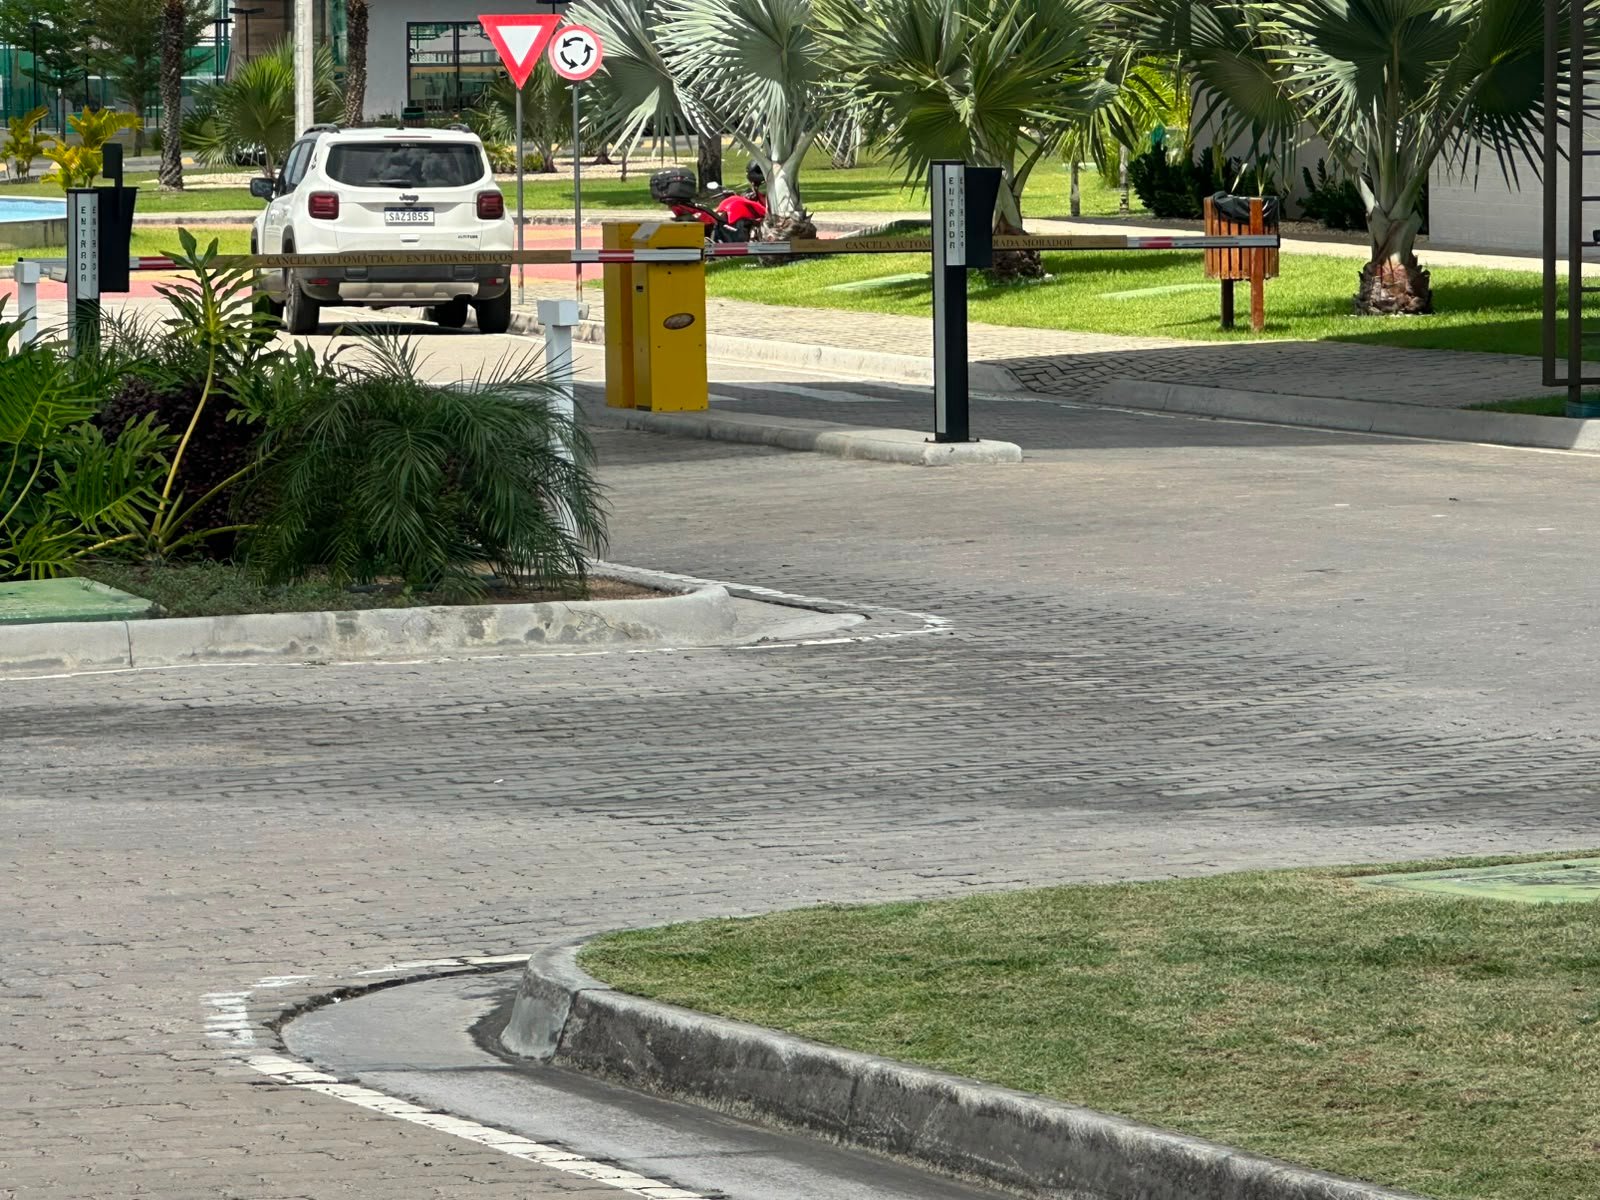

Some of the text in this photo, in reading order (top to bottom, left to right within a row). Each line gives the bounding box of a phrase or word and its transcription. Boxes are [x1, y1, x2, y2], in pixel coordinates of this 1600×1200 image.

[399, 193, 419, 202] Jeep
[845, 240, 891, 249] CANCELA
[894, 239, 931, 249] AUTOM
[1022, 239, 1072, 247] MORADOR
[266, 255, 317, 265] CANCELA
[320, 253, 396, 264] AUTOMÁTICA
[406, 254, 459, 263] ENTRADA
[462, 252, 513, 263] SERVIÇOS
